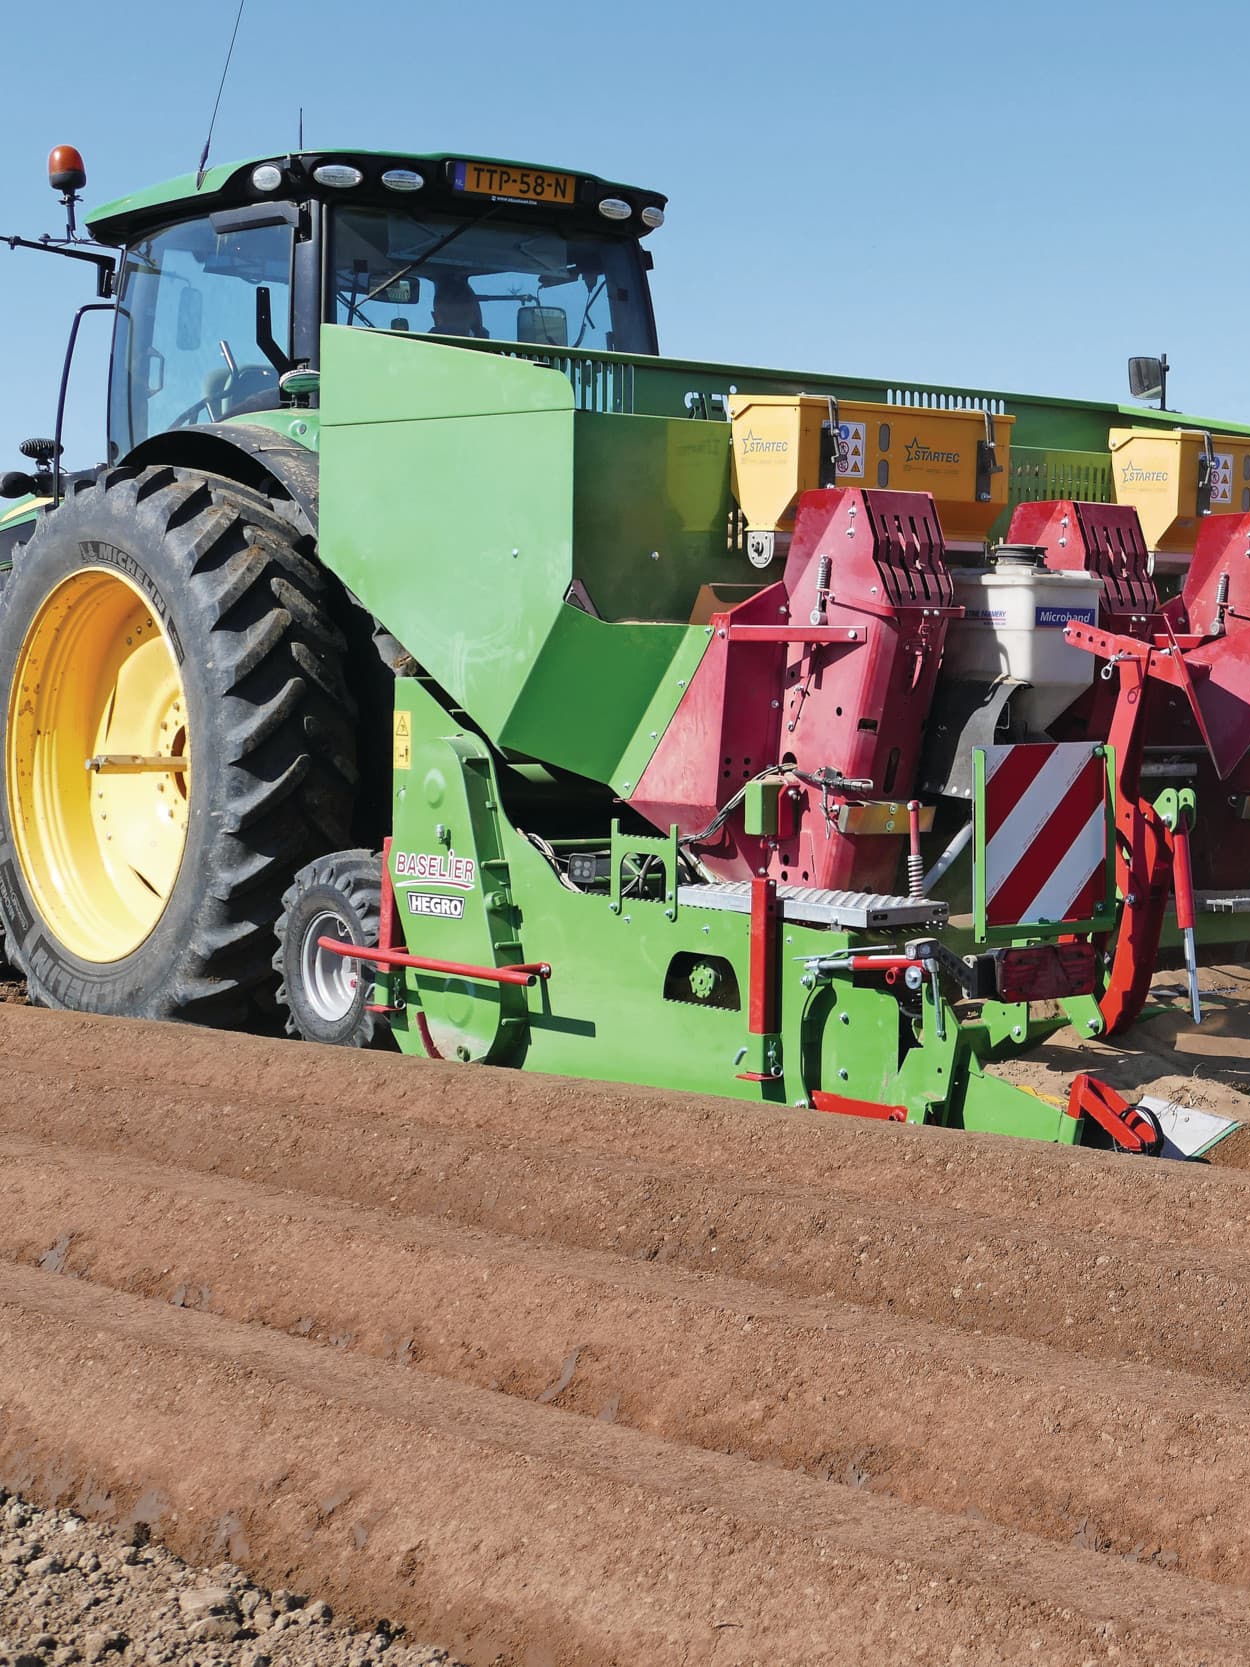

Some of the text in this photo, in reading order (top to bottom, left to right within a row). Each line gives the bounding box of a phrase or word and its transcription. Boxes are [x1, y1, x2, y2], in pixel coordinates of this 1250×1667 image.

[473, 166, 568, 199] TTP-58-N
[749, 441, 789, 454] STARTEC
[913, 449, 961, 464] STARTEC
[1128, 471, 1169, 482] STARTEC
[98, 542, 168, 620] MICHELIN
[1039, 610, 1091, 623] Microband
[410, 895, 462, 915] HEGRO
